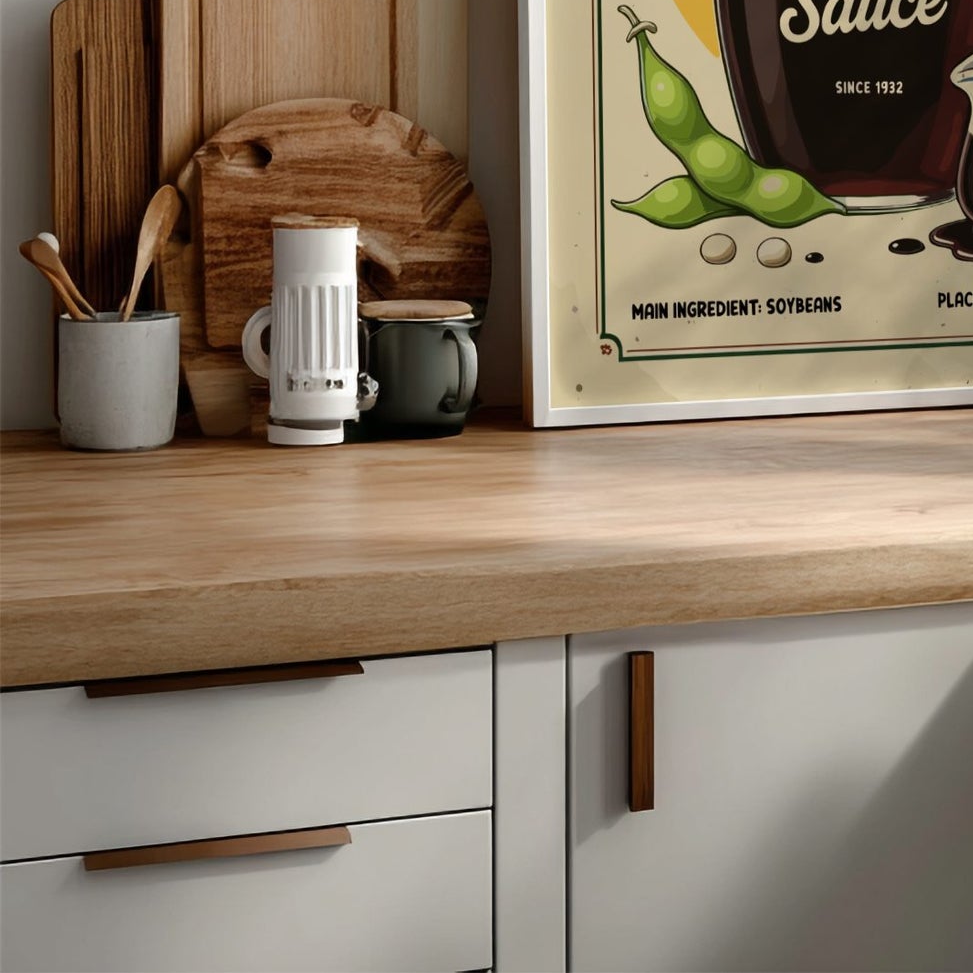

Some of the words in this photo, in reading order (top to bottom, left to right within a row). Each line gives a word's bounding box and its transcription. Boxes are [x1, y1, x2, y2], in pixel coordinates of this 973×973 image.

[835, 81, 871, 94] SINCE
[875, 81, 904, 94] 1932
[631, 302, 669, 321] MAIN
[672, 298, 762, 319] INGREDIENT:
[766, 295, 842, 315] SOYBEANS
